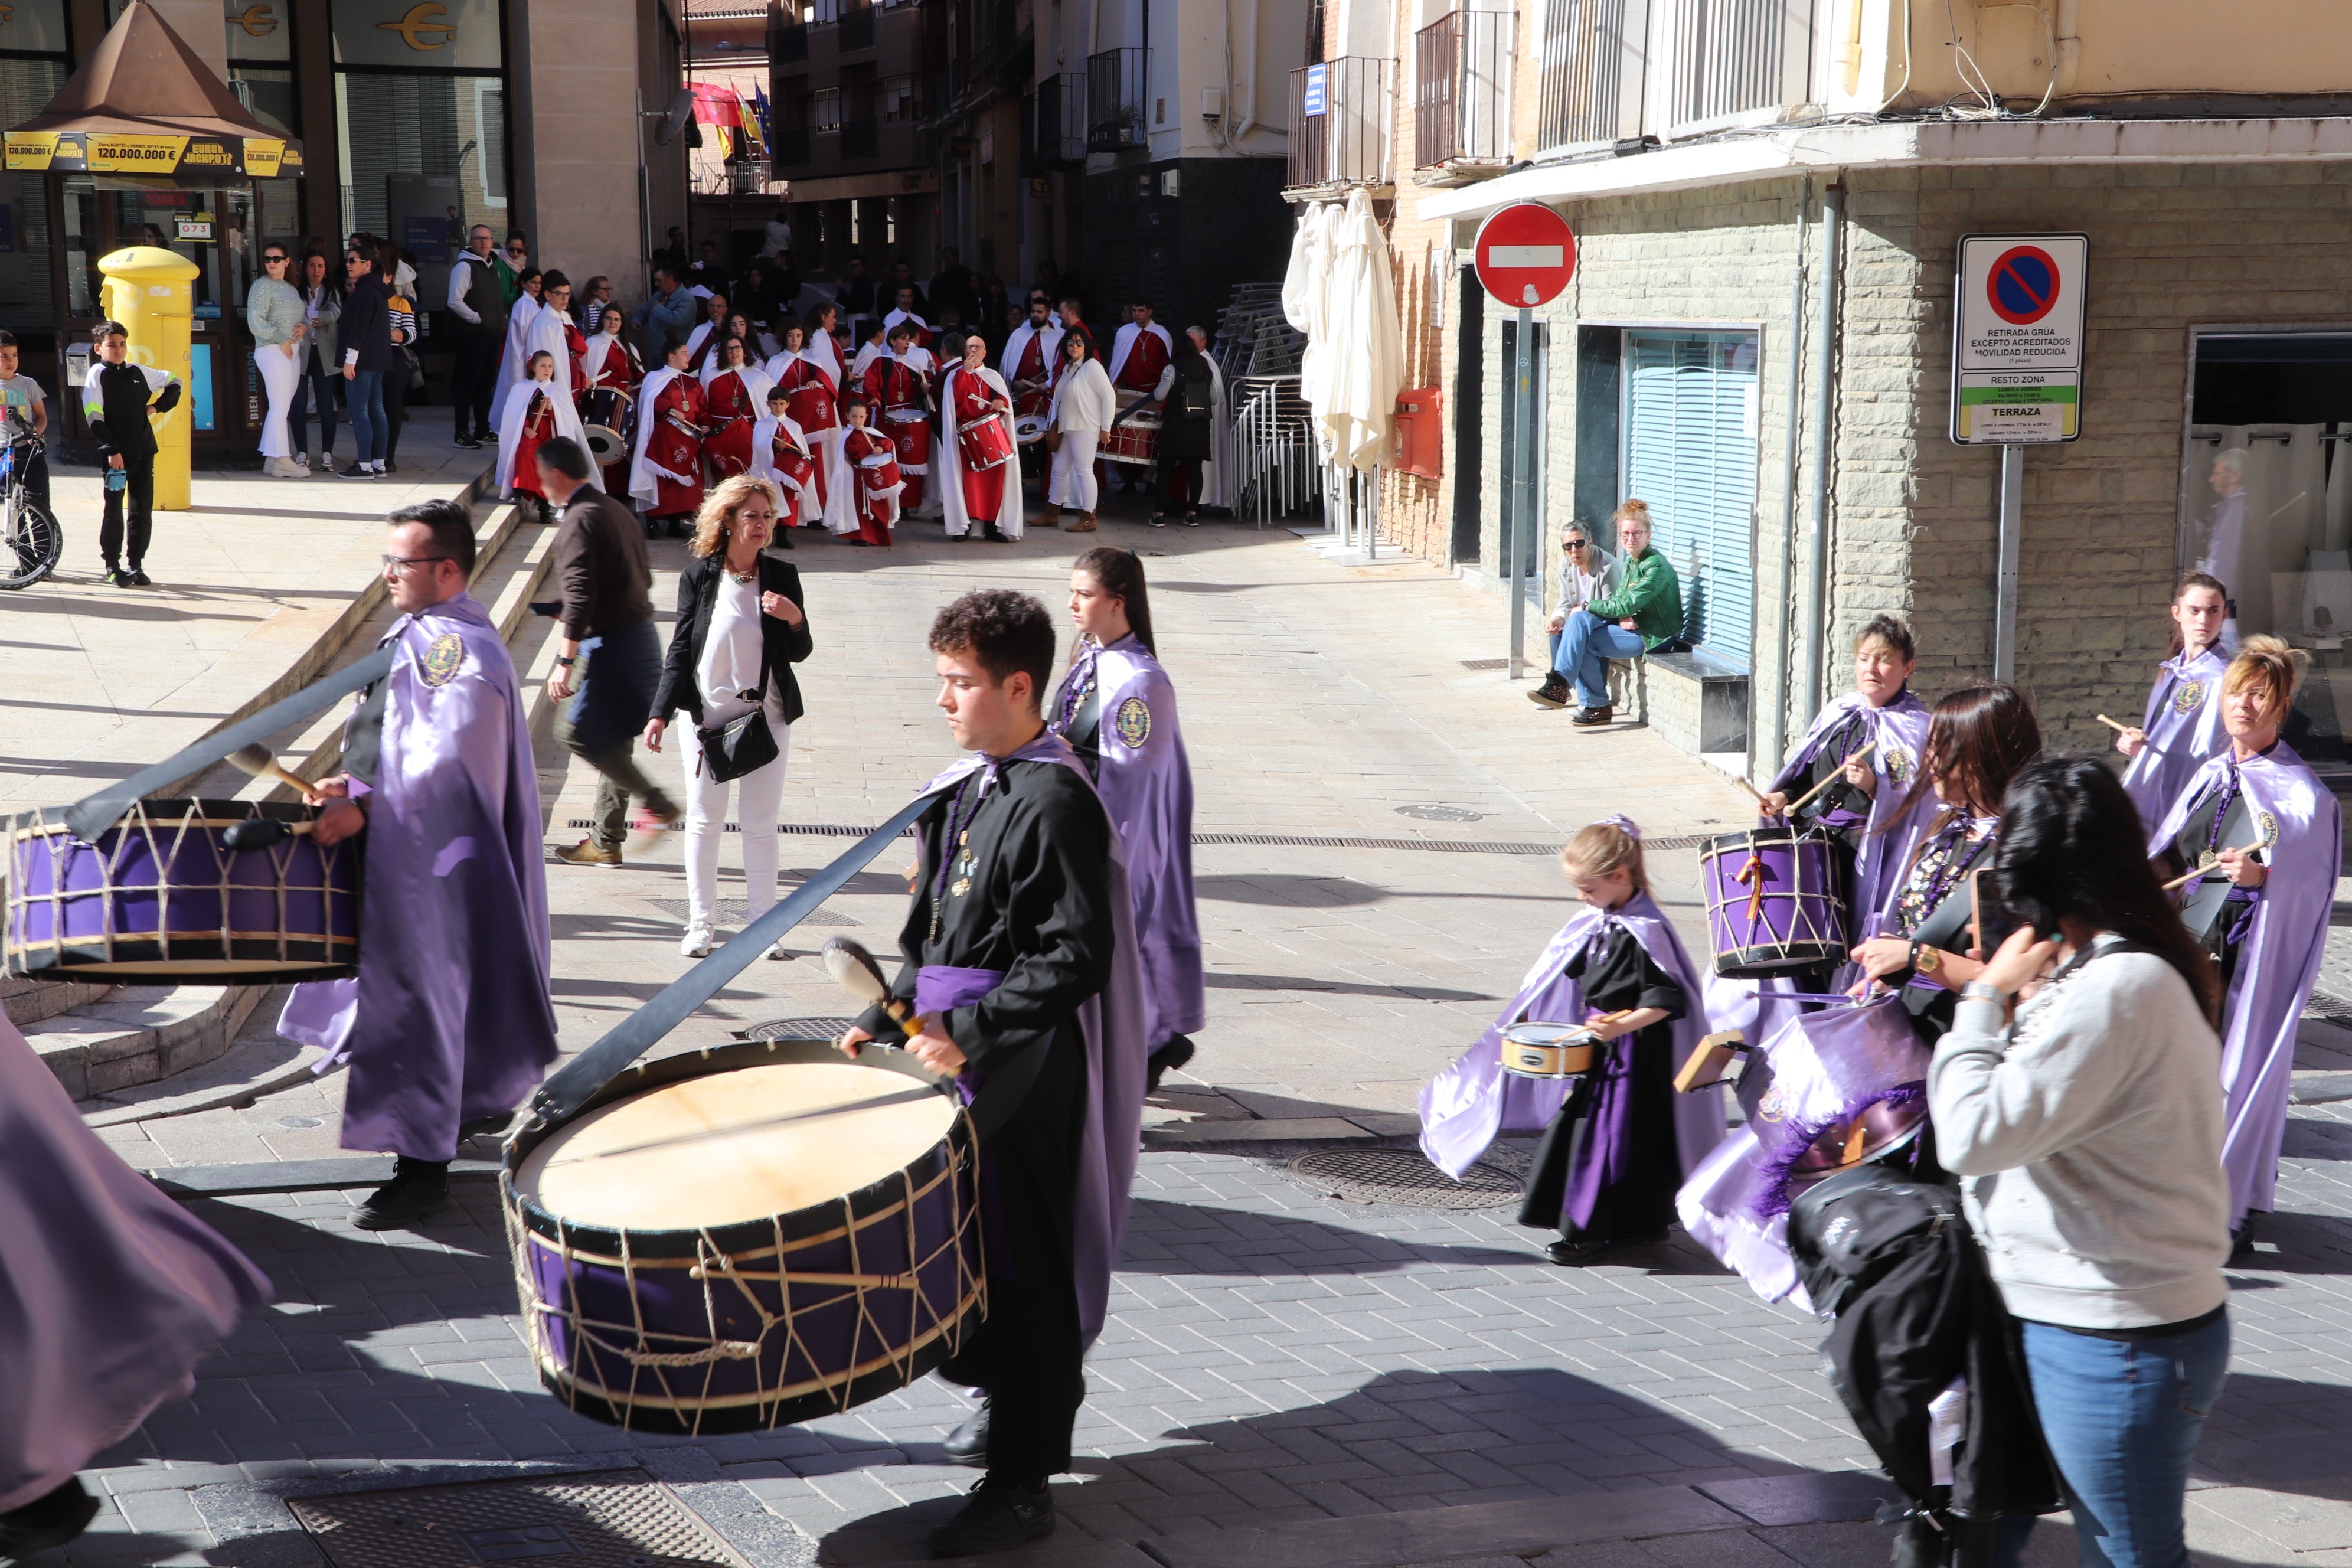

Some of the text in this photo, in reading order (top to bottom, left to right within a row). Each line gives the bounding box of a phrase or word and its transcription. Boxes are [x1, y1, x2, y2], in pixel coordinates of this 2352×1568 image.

[97, 148, 175, 160] 120.000.000 €
[192, 143, 221, 153] EURO
[184, 152, 231, 165] JACKPOT
[2031, 327, 2055, 335] GRÚA
[247, 352, 257, 393] JUGADO
[249, 396, 259, 420] BIEN
[1992, 408, 2041, 416] TERRAZA
